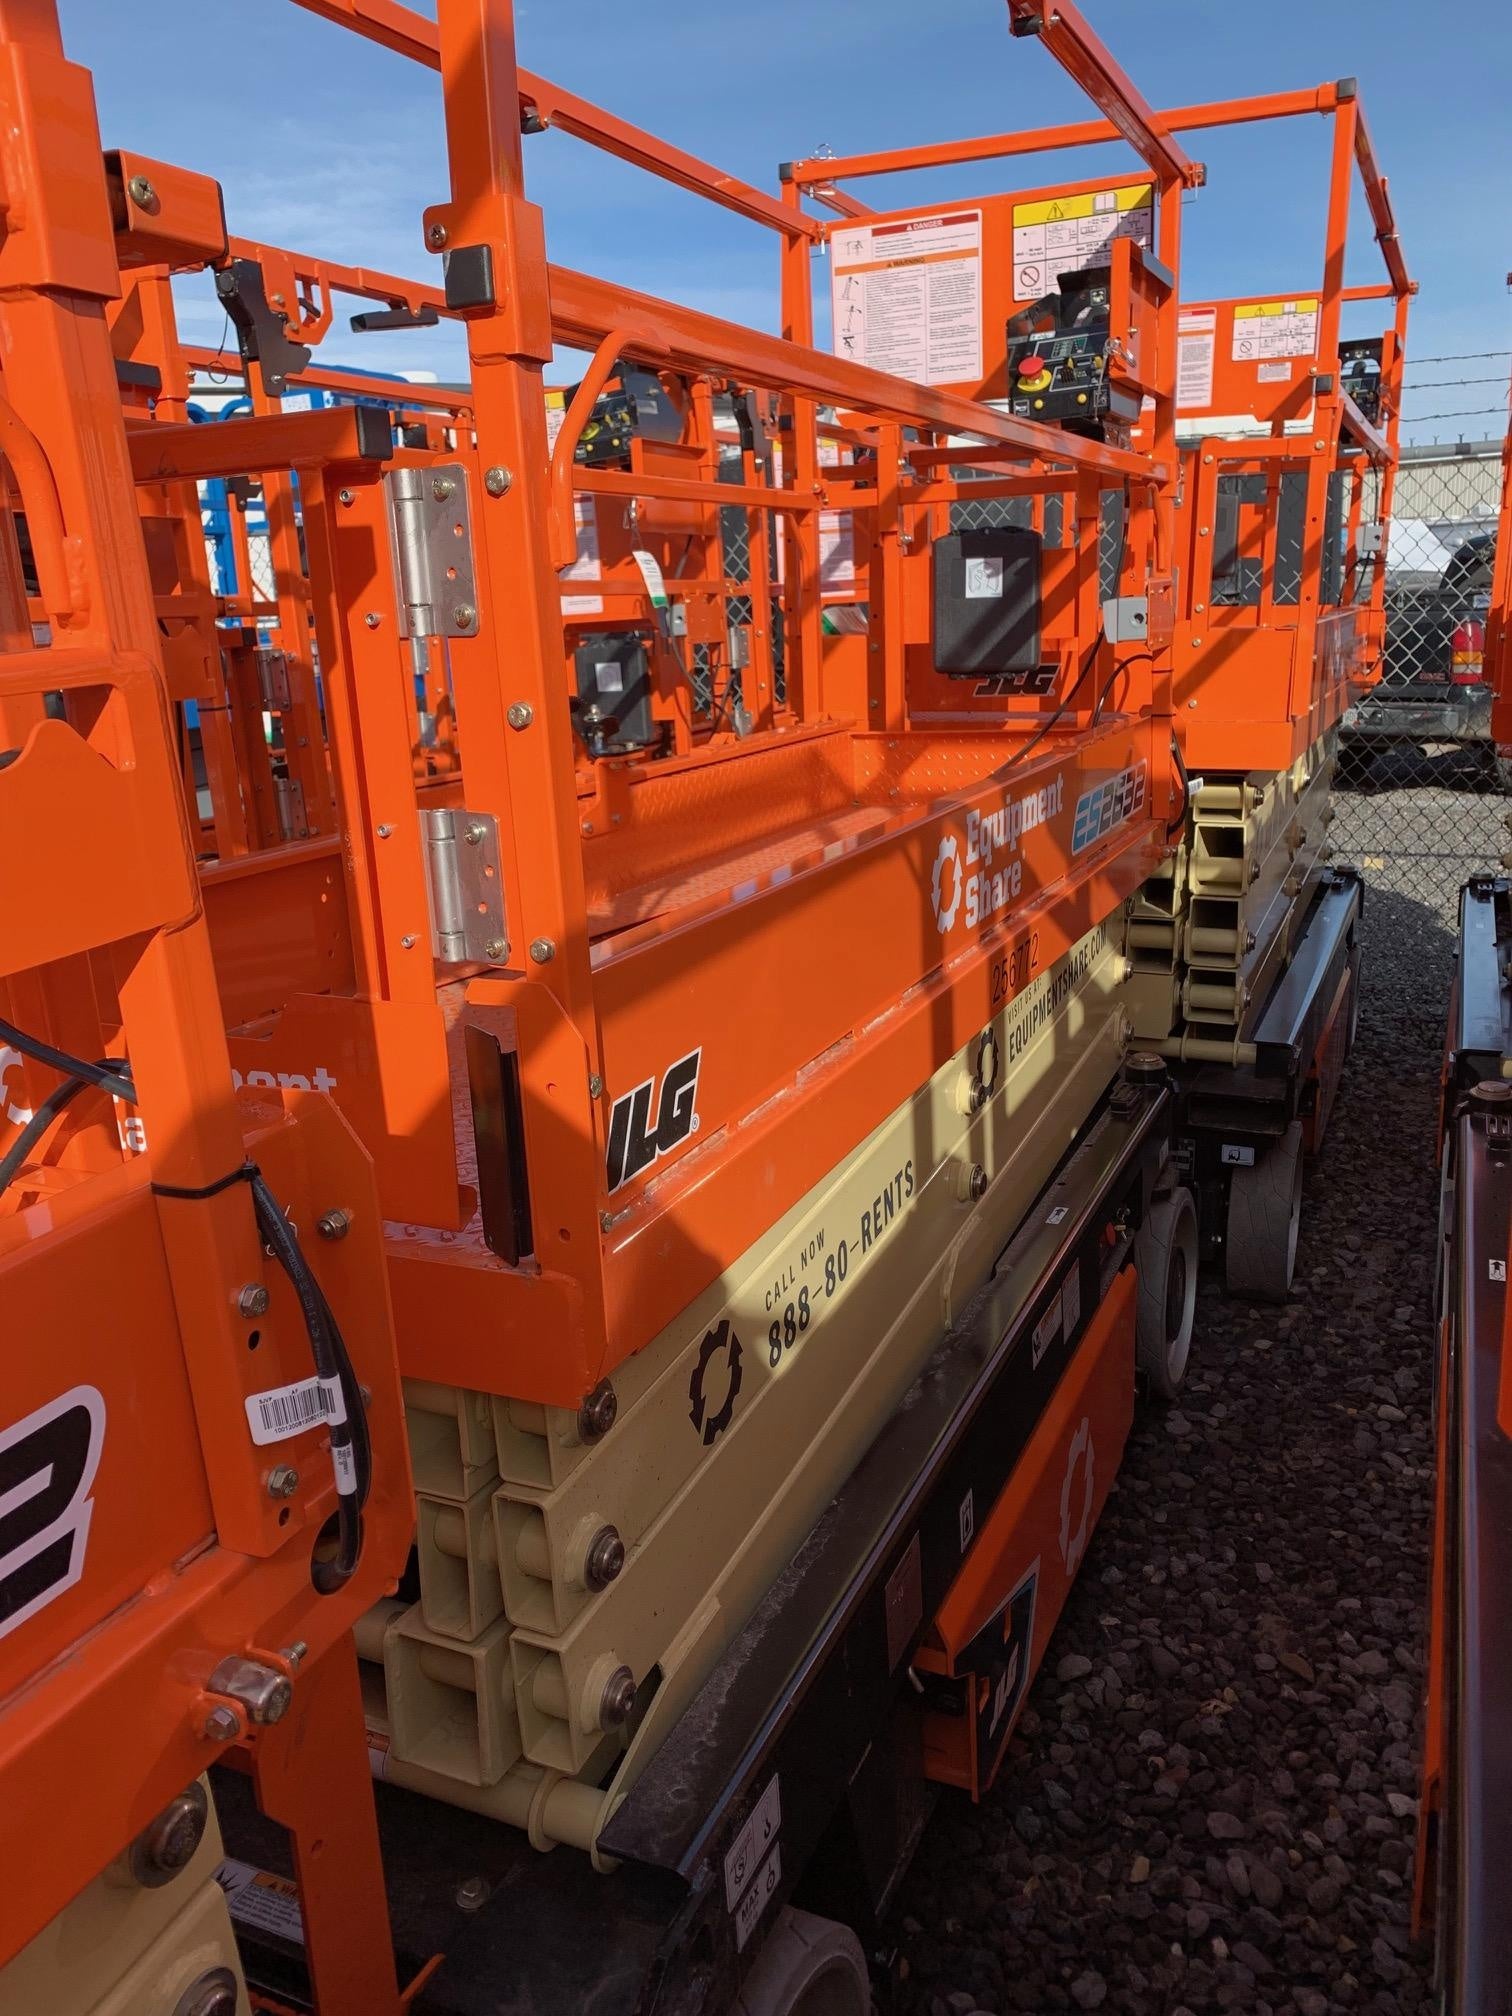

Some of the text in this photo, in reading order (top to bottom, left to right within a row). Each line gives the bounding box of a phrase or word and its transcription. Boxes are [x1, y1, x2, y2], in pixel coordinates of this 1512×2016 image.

[913, 219, 944, 231] DANGER
[965, 772, 1065, 867] Equipment
[965, 860, 1022, 930] Share
[992, 932, 1040, 1004] 256772
[1007, 996, 1024, 1024] VISIT
[1024, 986, 1033, 1005] US
[1008, 924, 1107, 1063] EQUIPMENTSHARE.COM
[606, 1046, 702, 1196] JLG
[765, 1227, 826, 1312] CALL NOW
[768, 1159, 915, 1369] 888-80-RENTS
